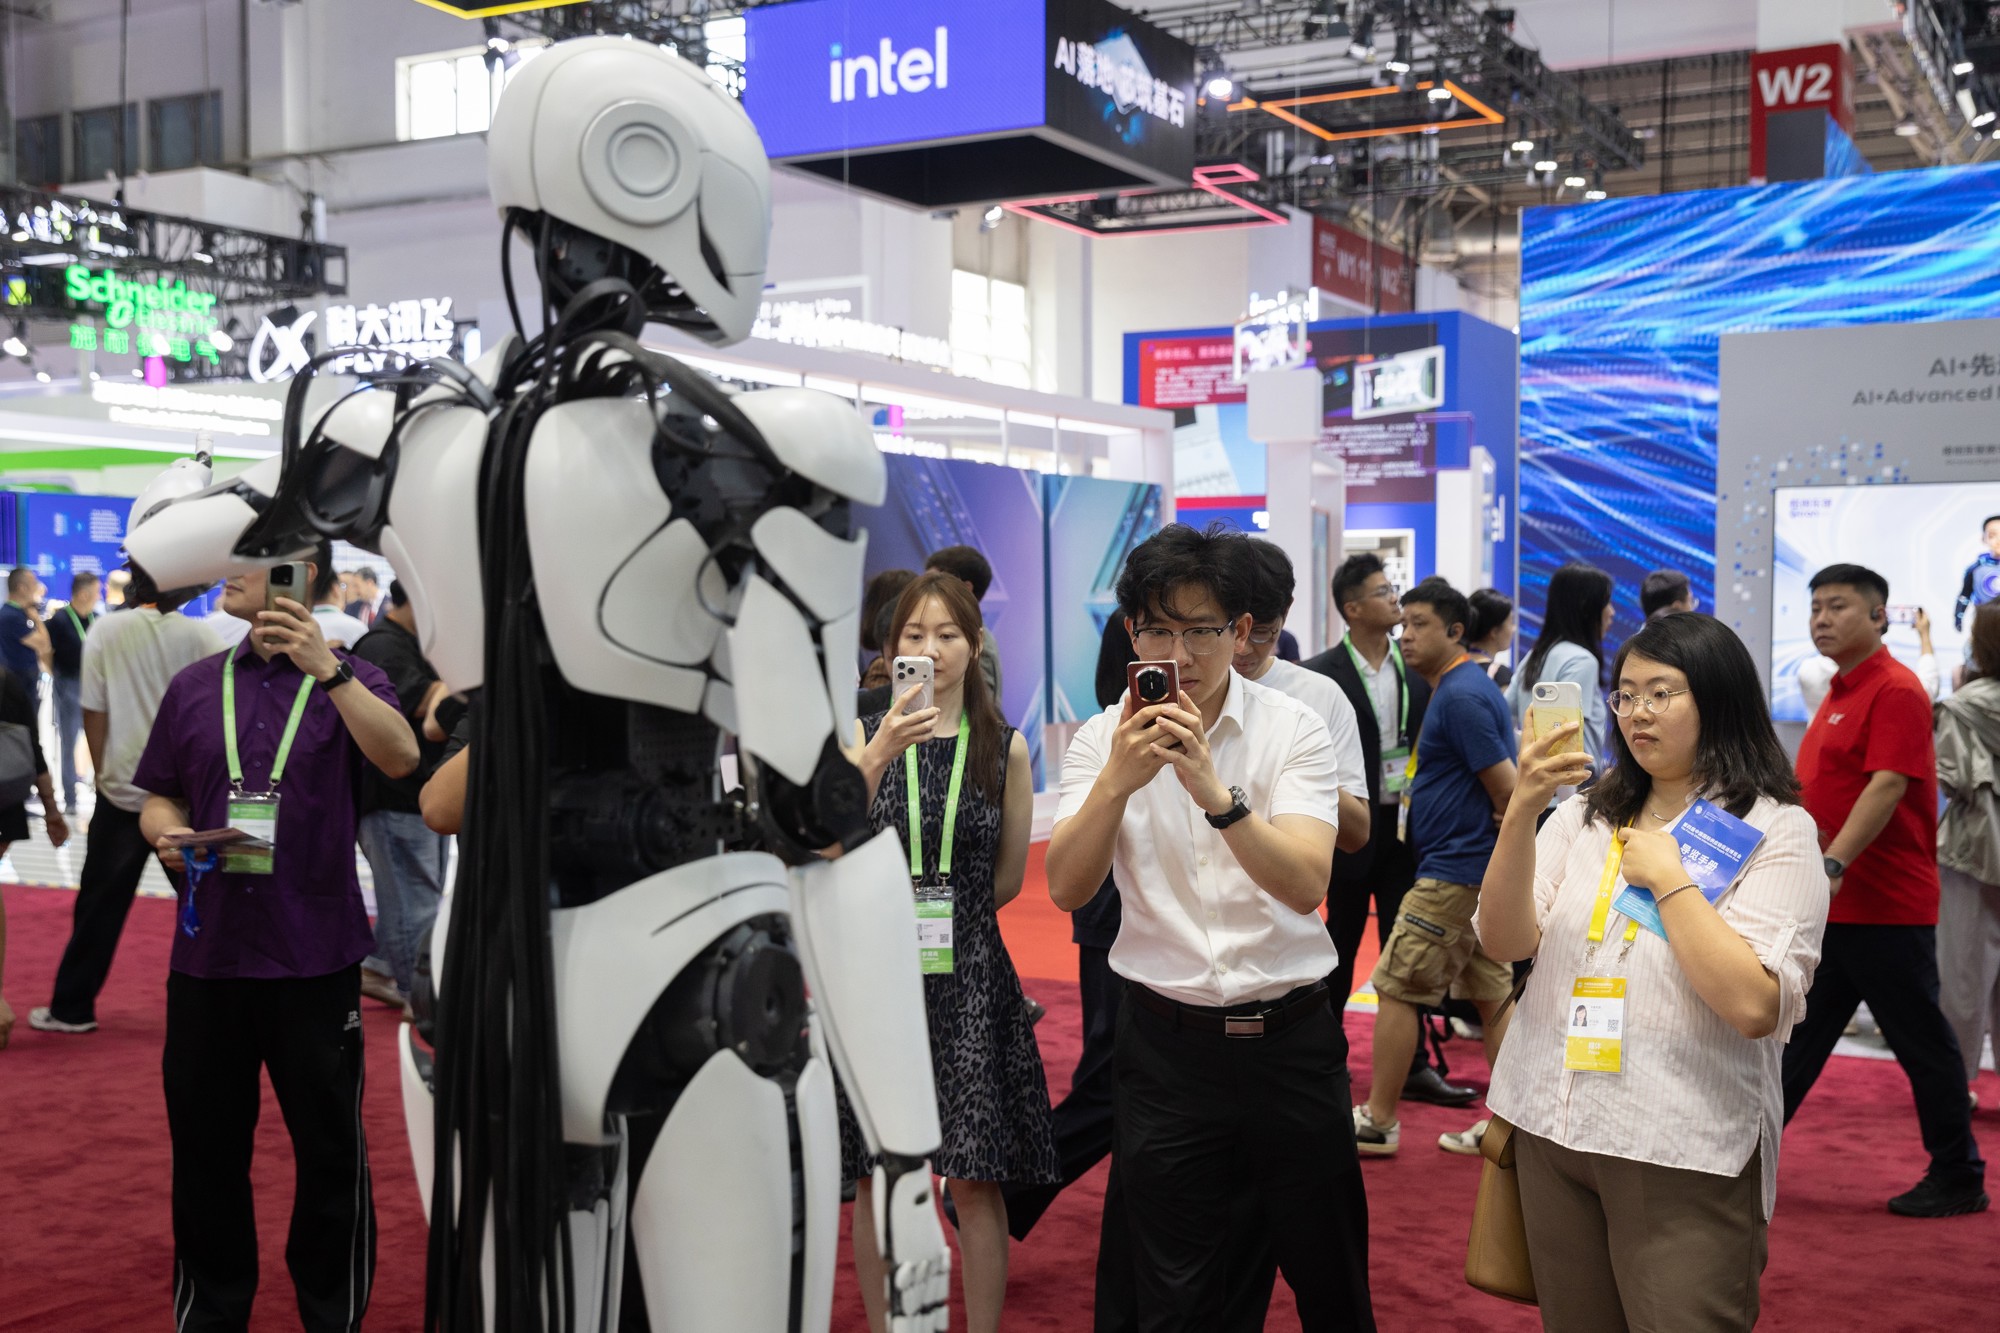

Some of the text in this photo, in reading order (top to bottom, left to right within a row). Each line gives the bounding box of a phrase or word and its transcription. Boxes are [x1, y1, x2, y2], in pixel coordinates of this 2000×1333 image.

[830, 25, 948, 103] intel
[1757, 63, 1832, 107] W2
[65, 264, 217, 317] Schneider
[1928, 352, 2000, 378] AI+先
[1852, 384, 1993, 405] AI+Advanced
[1680, 843, 1719, 872] 导览手册
